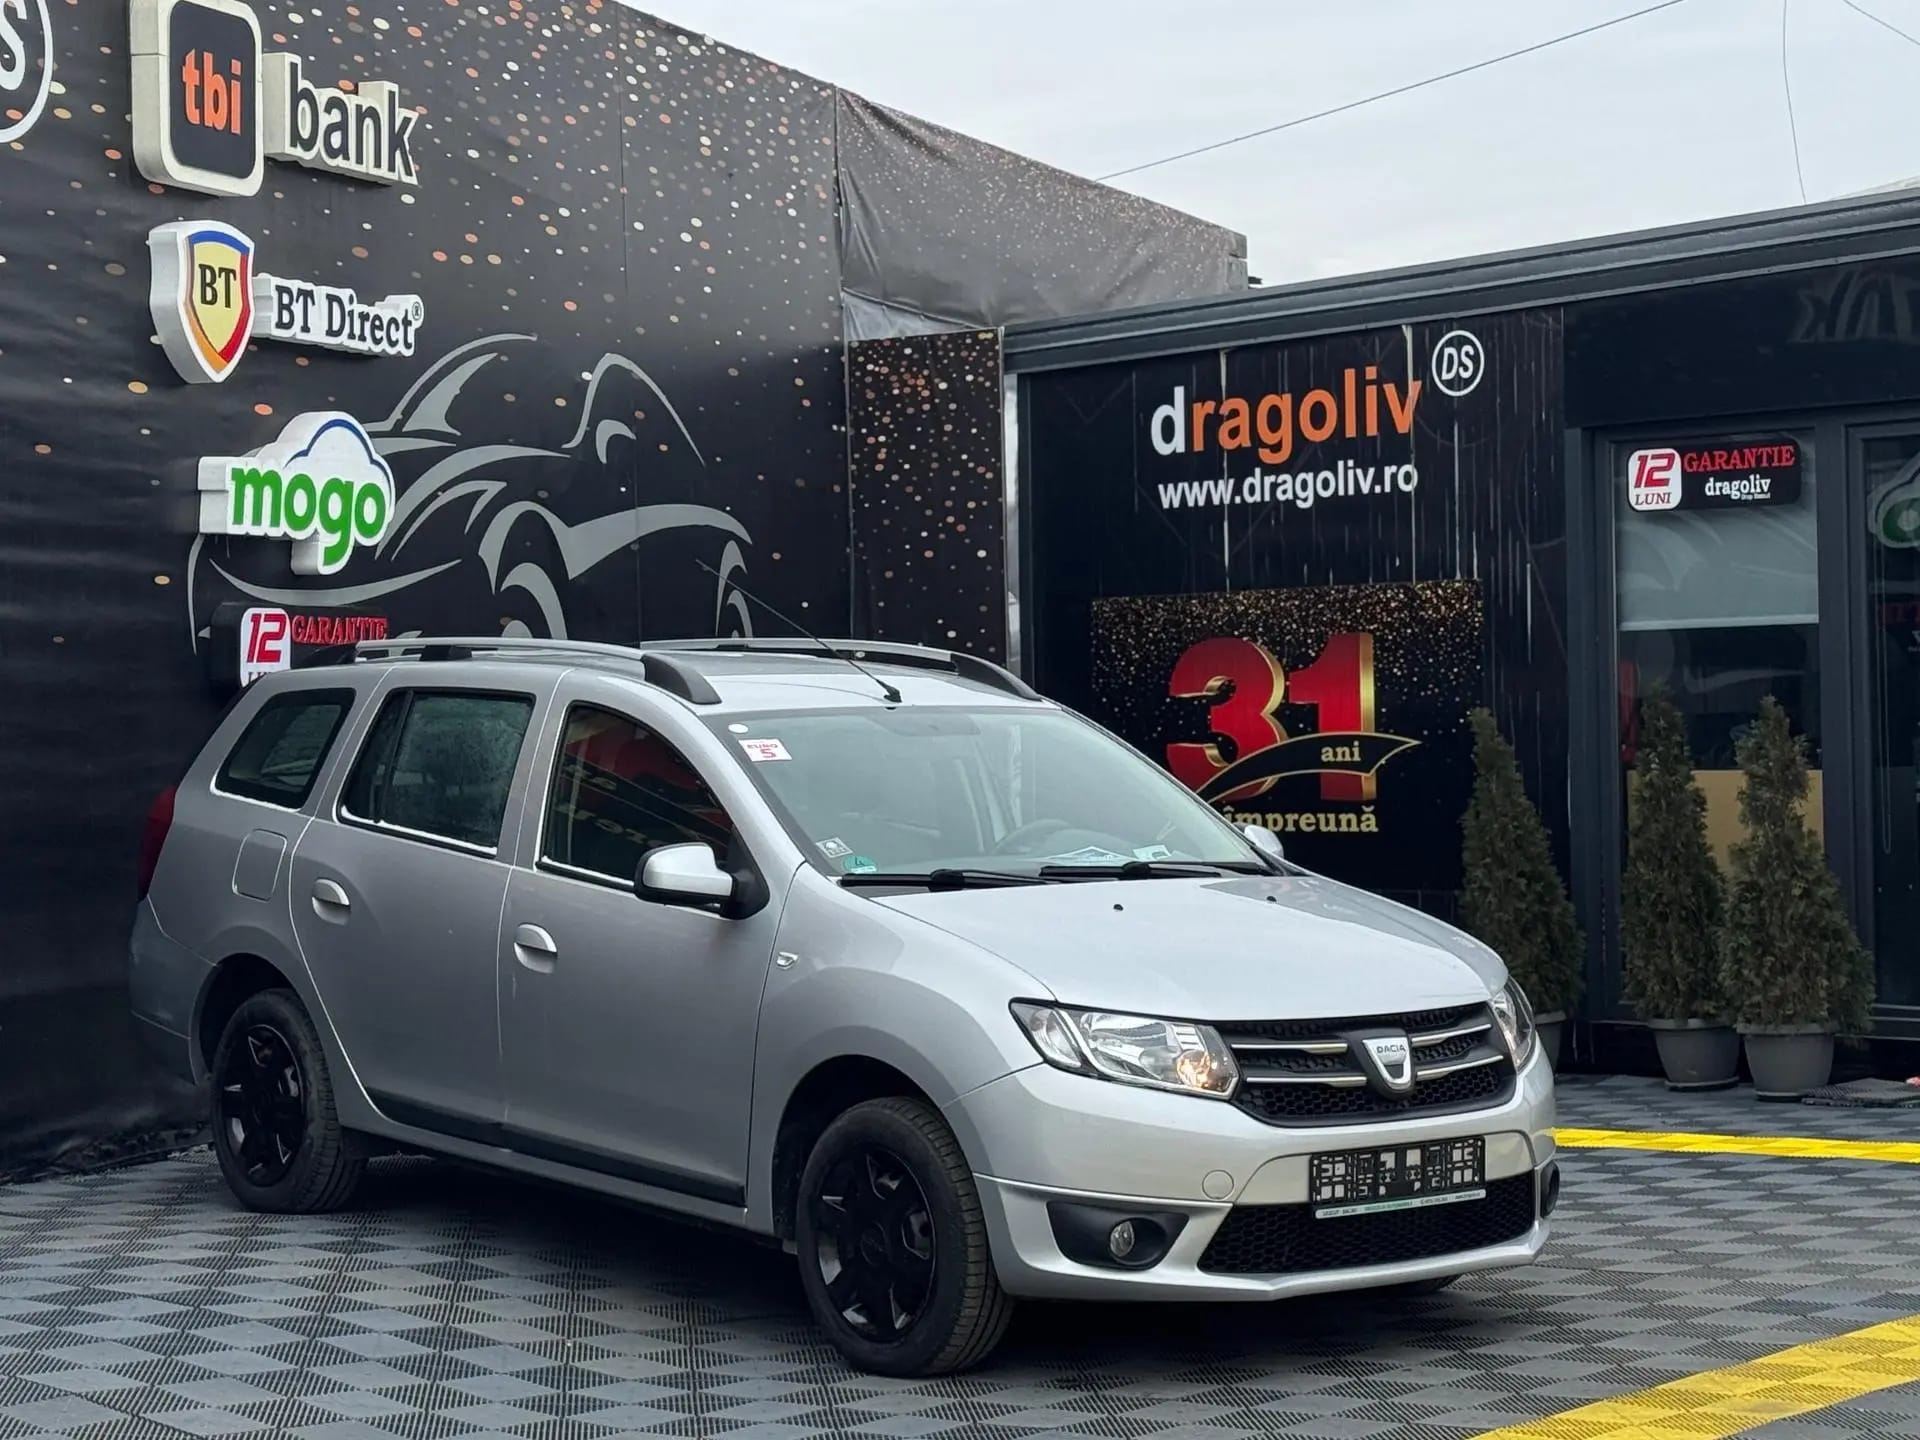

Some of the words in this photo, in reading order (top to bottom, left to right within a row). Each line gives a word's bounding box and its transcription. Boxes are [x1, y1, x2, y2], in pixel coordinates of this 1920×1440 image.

[182, 48, 242, 135] tbi
[289, 61, 415, 179] bank
[198, 263, 237, 308] BT
[275, 284, 316, 333] BT
[1440, 344, 1475, 381] DS
[1150, 366, 1423, 465] dragoliv
[1158, 459, 1419, 510] www.dragoliv.ro
[1633, 453, 1676, 489] 12
[1683, 445, 1796, 472] GARANTIE
[1704, 473, 1772, 500] dragoliv
[231, 467, 386, 566] mogo
[1634, 492, 1673, 506] LUNI
[246, 613, 288, 663] 12
[291, 615, 388, 645] GARANTIE
[1166, 632, 1377, 799] 31
[760, 748, 778, 759] 5
[1320, 740, 1363, 763] ani
[1376, 1044, 1407, 1054] DACIA
